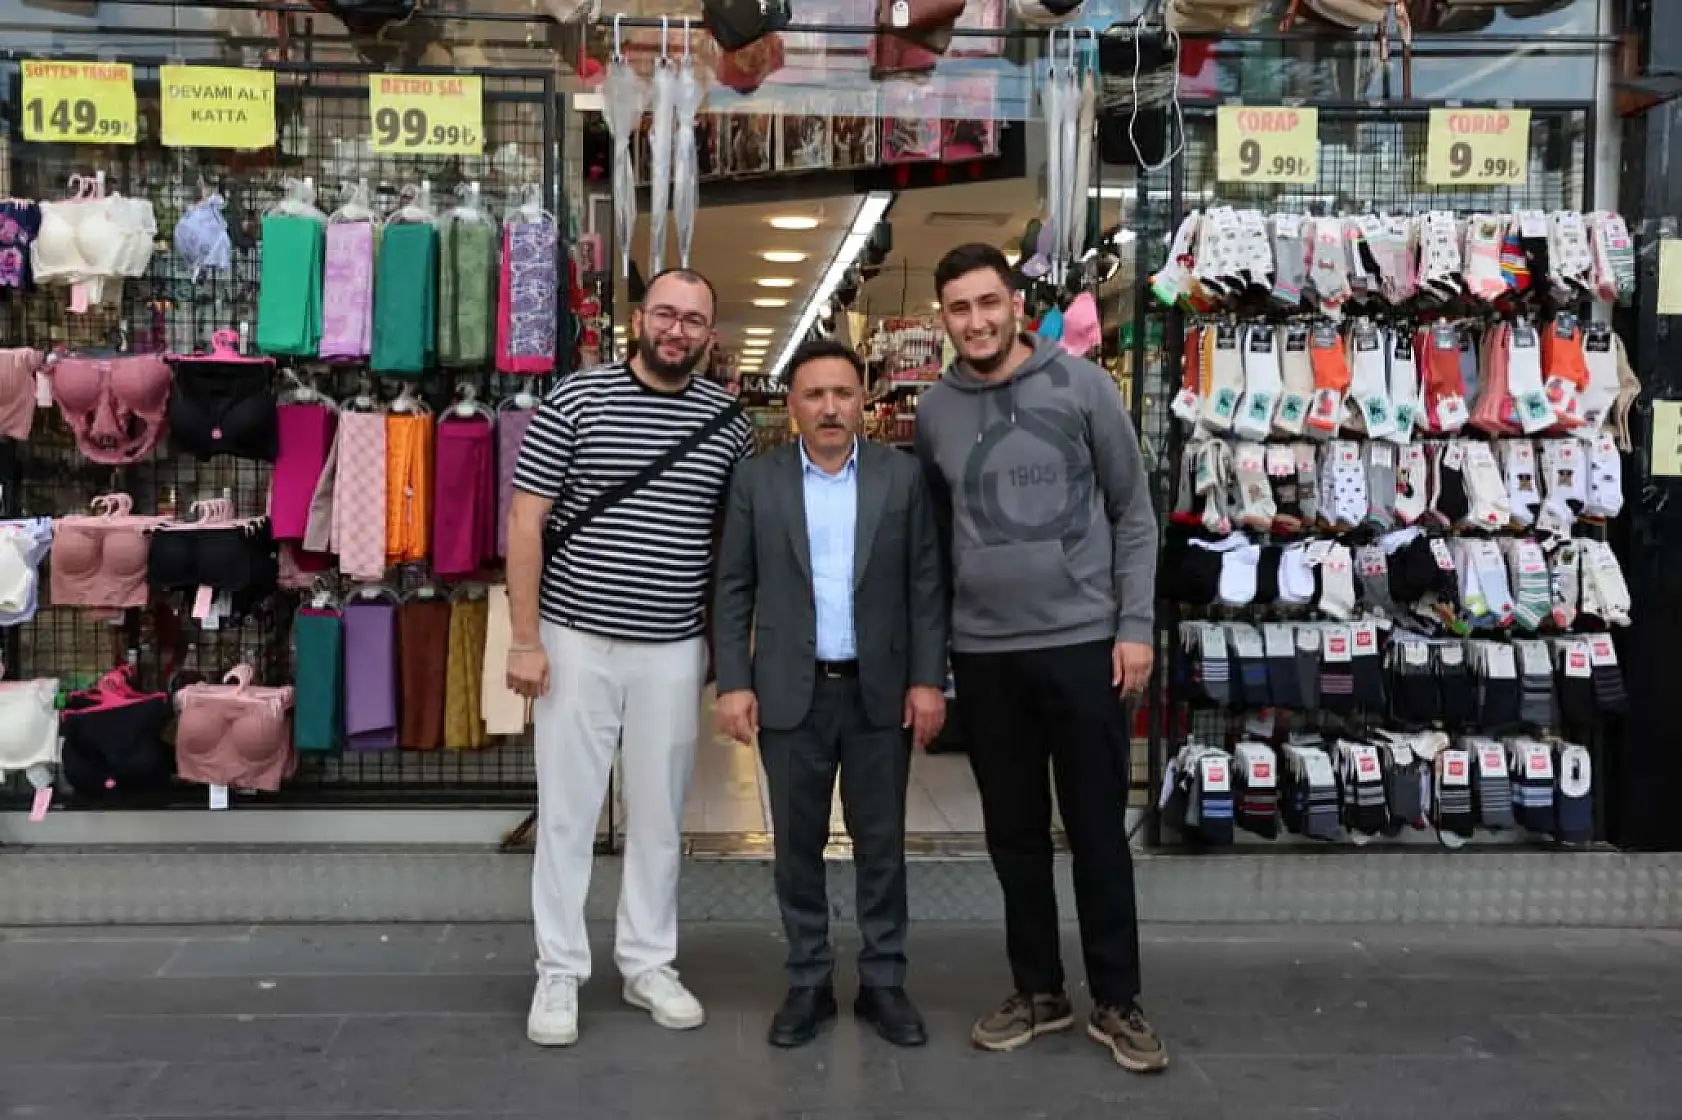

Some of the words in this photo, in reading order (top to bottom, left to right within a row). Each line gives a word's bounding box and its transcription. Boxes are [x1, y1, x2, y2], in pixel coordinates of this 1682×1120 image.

[168, 84, 233, 100] DEVAMI
[238, 86, 271, 103] ALT
[191, 107, 247, 122] KATTA
[1008, 462, 1058, 488] 1905
